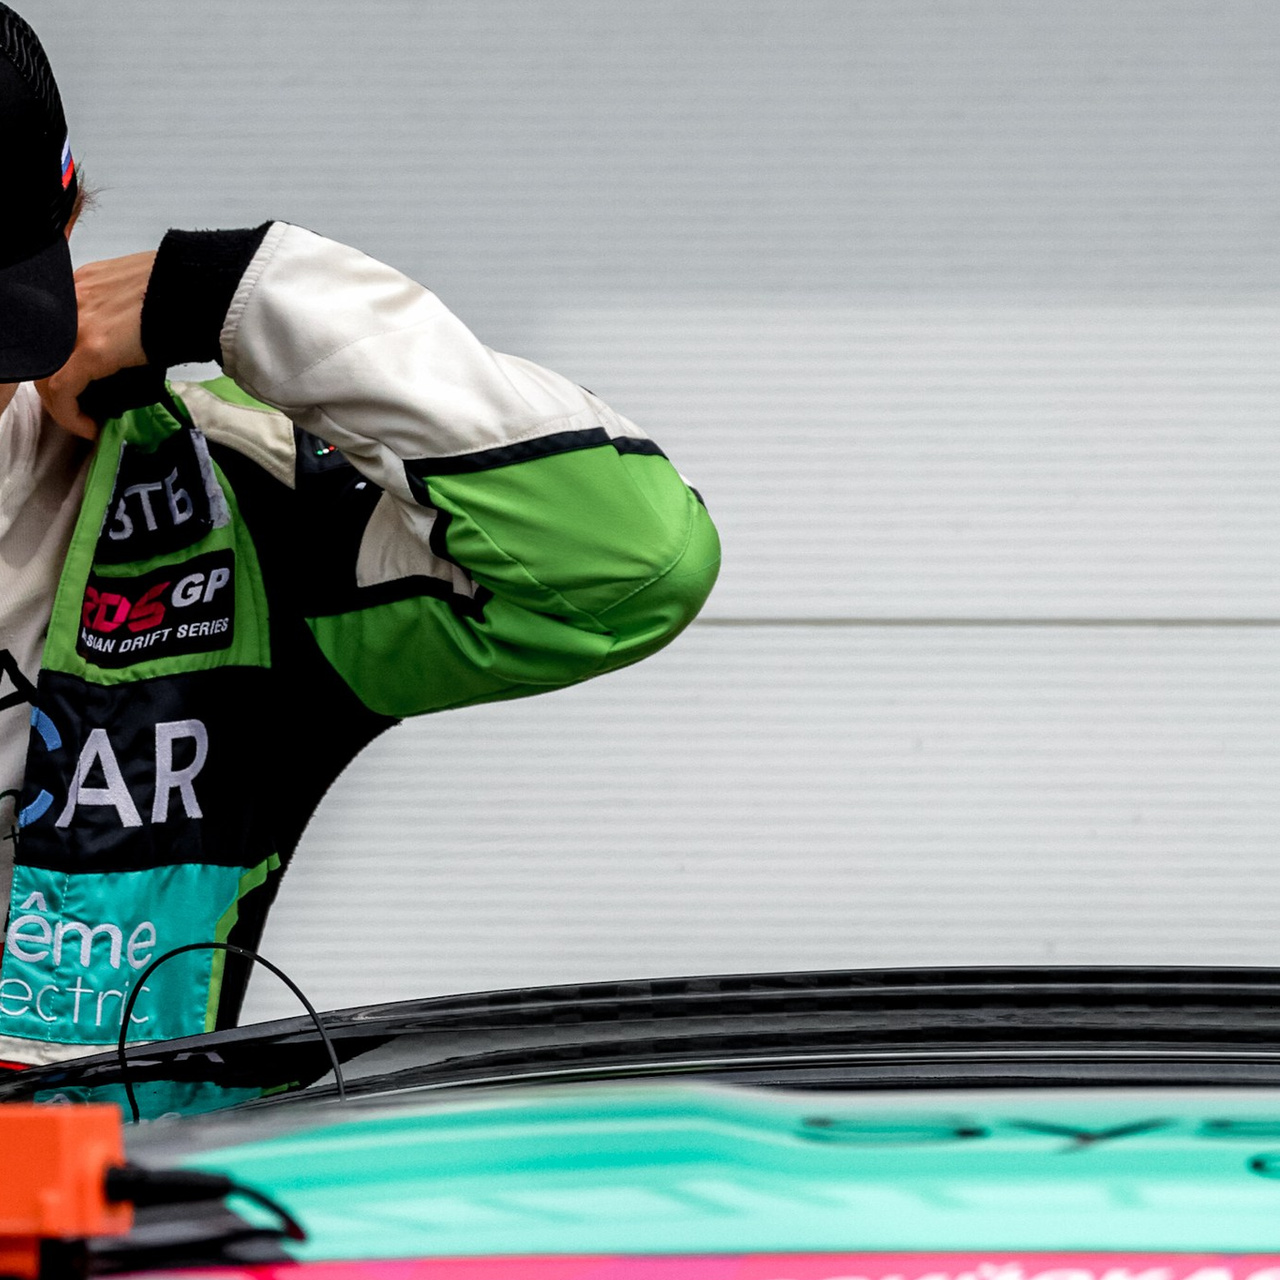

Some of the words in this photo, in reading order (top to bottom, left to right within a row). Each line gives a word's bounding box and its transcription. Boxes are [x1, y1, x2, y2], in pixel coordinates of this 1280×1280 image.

[171, 567, 230, 608] GP
[118, 628, 173, 654] DRIFT
[176, 617, 229, 639] SERIES
